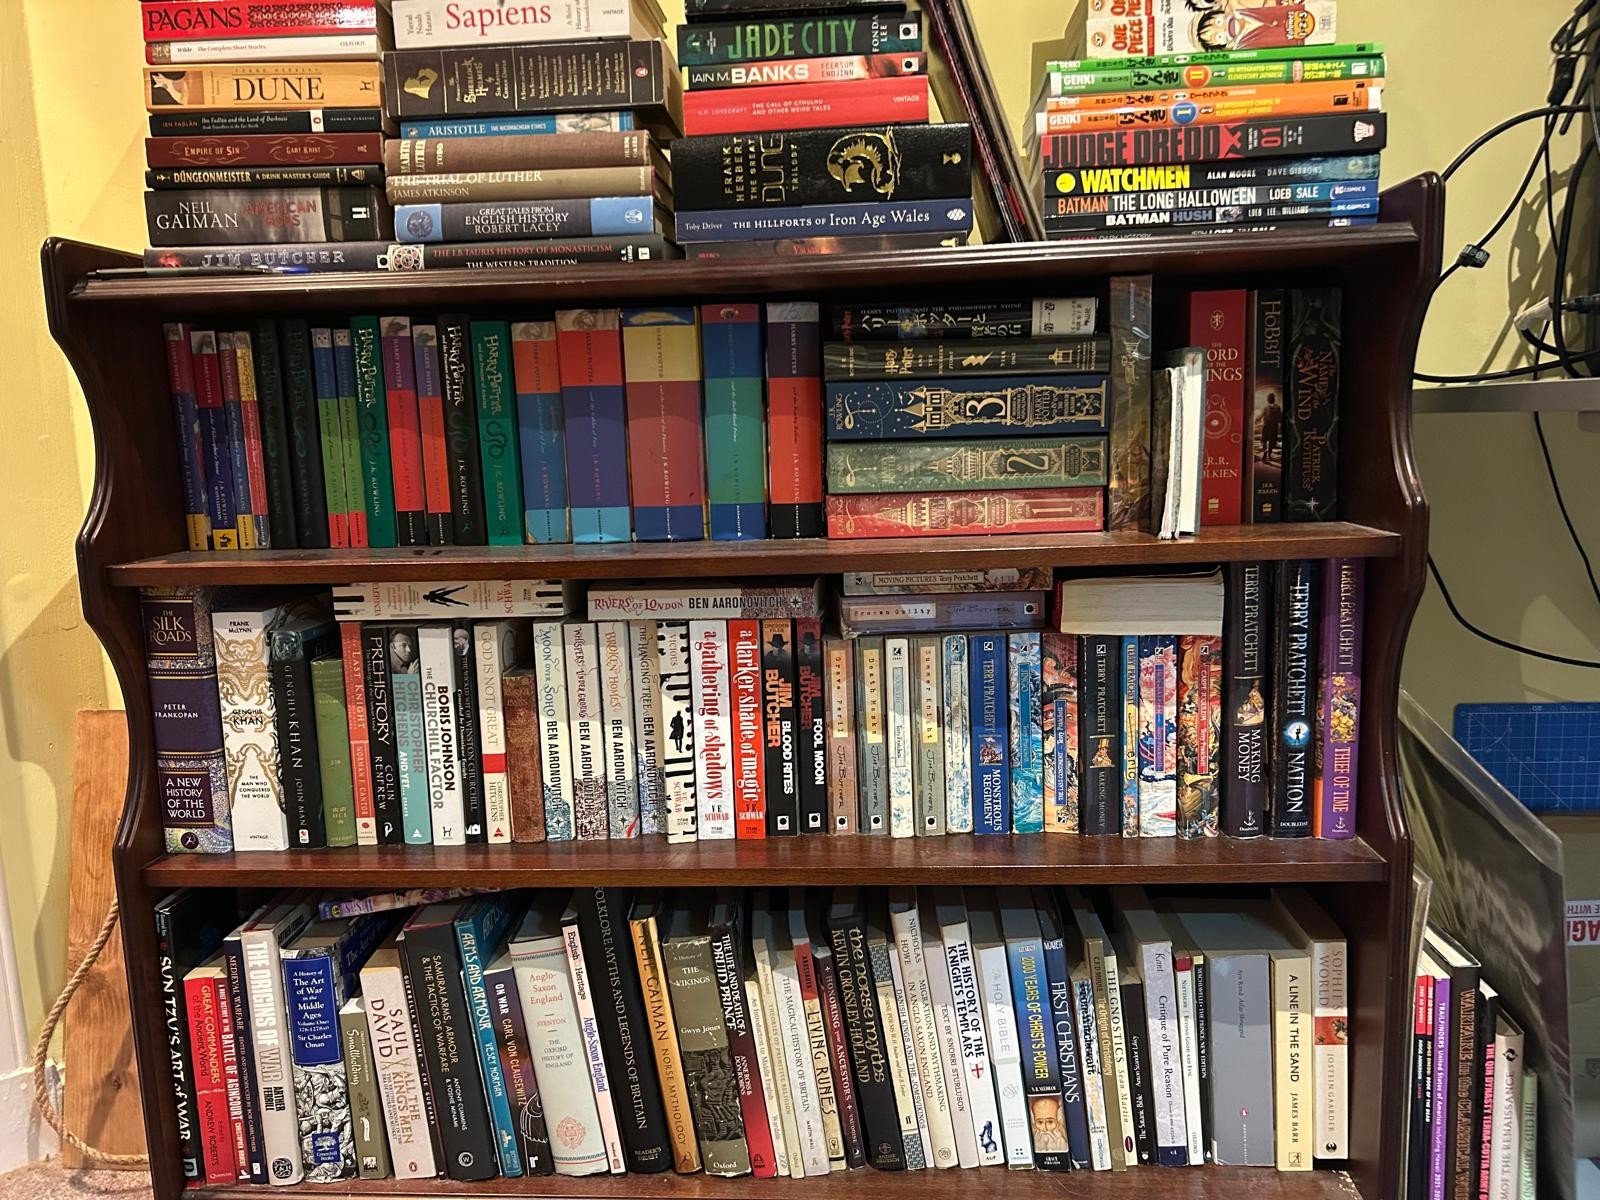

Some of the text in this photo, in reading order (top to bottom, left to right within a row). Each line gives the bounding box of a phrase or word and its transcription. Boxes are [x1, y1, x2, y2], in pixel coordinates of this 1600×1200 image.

[148, 7, 242, 31] PAGANS
[446, 3, 552, 37] Sapiens
[727, 22, 795, 59] JADE
[801, 20, 857, 54] CITY
[871, 14, 879, 52] FONDA
[880, 24, 888, 42] LEE
[1112, 24, 1127, 51] ONE
[1128, 18, 1143, 54] PIECE
[234, 77, 324, 101] DUNE
[692, 64, 809, 83] IAIN M. BANKS
[1064, 75, 1095, 85] GENKI
[1133, 70, 1178, 85] げんき
[893, 95, 919, 103] VINTAGE
[1050, 114, 1080, 125] GENKI
[1118, 108, 1166, 124] げんき
[1044, 130, 1127, 167] JUDGE
[1134, 124, 1221, 164] DREDD
[723, 147, 733, 194] FRANK
[733, 137, 744, 201] HERBERT
[760, 134, 785, 202] DUNE
[1081, 165, 1190, 193] WATCHMEN
[179, 202, 214, 214] NEIL
[394, 187, 469, 199] JAMES ATKINSON
[1057, 187, 1256, 214] BATMAN THE LONG HALLOWEEN
[1269, 186, 1319, 200] LOEB SALE
[157, 213, 239, 229] GAIMAN
[465, 213, 569, 225] ENGLISH HISTORY
[475, 222, 560, 234] ROBERT LACEY
[733, 208, 930, 229] THE HILLFORTS OF Iron Age Wales
[1105, 210, 1212, 227] BATMAN HUSH
[1260, 300, 1281, 368] HOBBIT
[447, 326, 467, 407] HARRY POTTER
[965, 397, 1006, 417] 3
[1302, 431, 1314, 491] ROTHFUSS
[1311, 433, 1329, 482] PATRICK
[153, 616, 184, 630] SILK
[153, 630, 192, 646] ROADS
[352, 651, 366, 729] LAST KNIGHT
[371, 637, 390, 744] PREHISTORY
[695, 640, 724, 717] gathering
[1286, 583, 1310, 812] TERRY PRATCHETT NATION
[285, 665, 303, 769] GENGHIS KHAN
[704, 719, 721, 731] of
[733, 630, 762, 802] a darker shade of magic
[764, 670, 794, 795] JIM BUTCHER BLOOD RITES
[437, 686, 455, 791] BORIS JOHNSON
[166, 778, 202, 787] A NEW
[375, 756, 387, 810] RENFREW
[384, 765, 395, 800] COLIN
[700, 734, 726, 799] shadows
[166, 788, 203, 797] HISTORY
[167, 799, 205, 808] OF THE
[982, 769, 1003, 831] MONSTROUS REGIMENT
[168, 809, 206, 819] WORLD
[1568, 905, 1591, 914] WITH
[462, 933, 491, 1030] ARMS AND ARMOUR
[956, 941, 985, 1058] THE HISTORY OF THE
[1318, 955, 1330, 1006] WORLD
[247, 941, 284, 1081] THE ORIGINS OF WAR
[832, 929, 870, 1083] KEVIN CROSSLEY-HOLLAND
[848, 927, 887, 1083] the norse myths
[947, 946, 974, 1058] KNIGHTS TEMPLARS
[201, 985, 220, 1083] GREAT COMMANDERS
[371, 999, 392, 1058] DAVID
[389, 1008, 408, 1055] SAUL
[494, 983, 527, 1106] ON WAR CARL VON CLAUSEWITZ
[604, 946, 647, 1129] MYTHS AND LEGENDS OF BRITAIN
[1050, 981, 1079, 1103] FIRST CHRISTIANS
[1155, 953, 1174, 1098] Kant Critique of Pure Reason
[1290, 974, 1300, 1082] A LINE IN THE SAND
[1438, 1002, 1446, 1048] TRAILFINDERS
[160, 956, 192, 1141] SUN TZU'S ART of WAR
[346, 1029, 360, 1085] Smallholding
[1437, 1050, 1445, 1070] United
[1436, 1072, 1444, 1092] States
[1435, 1100, 1443, 1125] America
